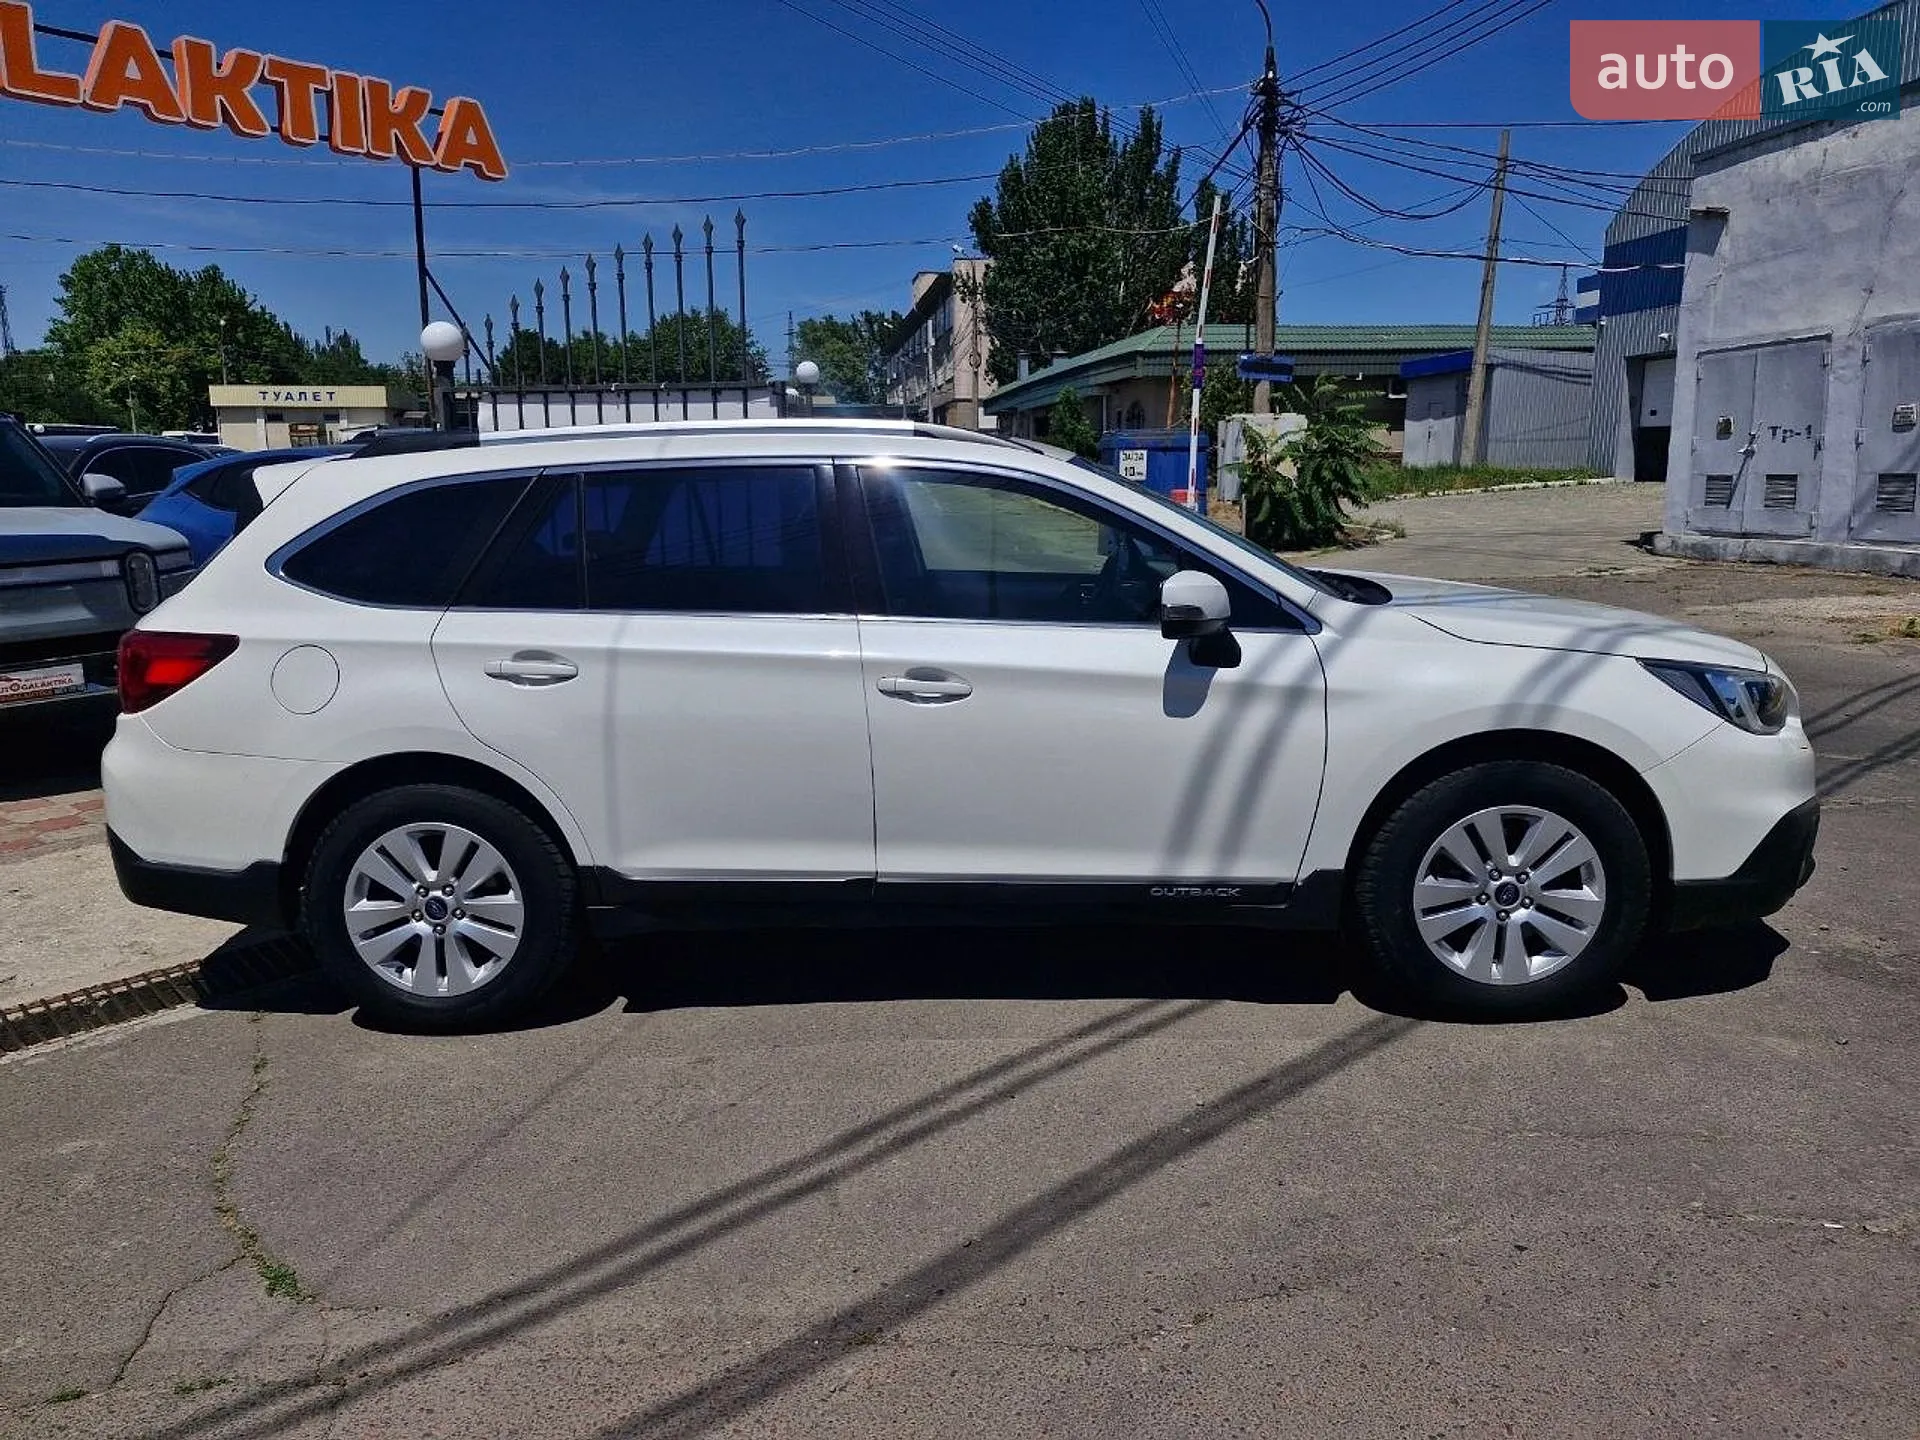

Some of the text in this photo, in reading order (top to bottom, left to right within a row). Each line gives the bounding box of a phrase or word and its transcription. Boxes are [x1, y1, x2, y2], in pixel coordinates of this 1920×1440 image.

[0, 0, 508, 180] LAKTIKA
[259, 391, 336, 402] ТУАЛЕТ
[1150, 887, 1241, 897] OUTBACK
